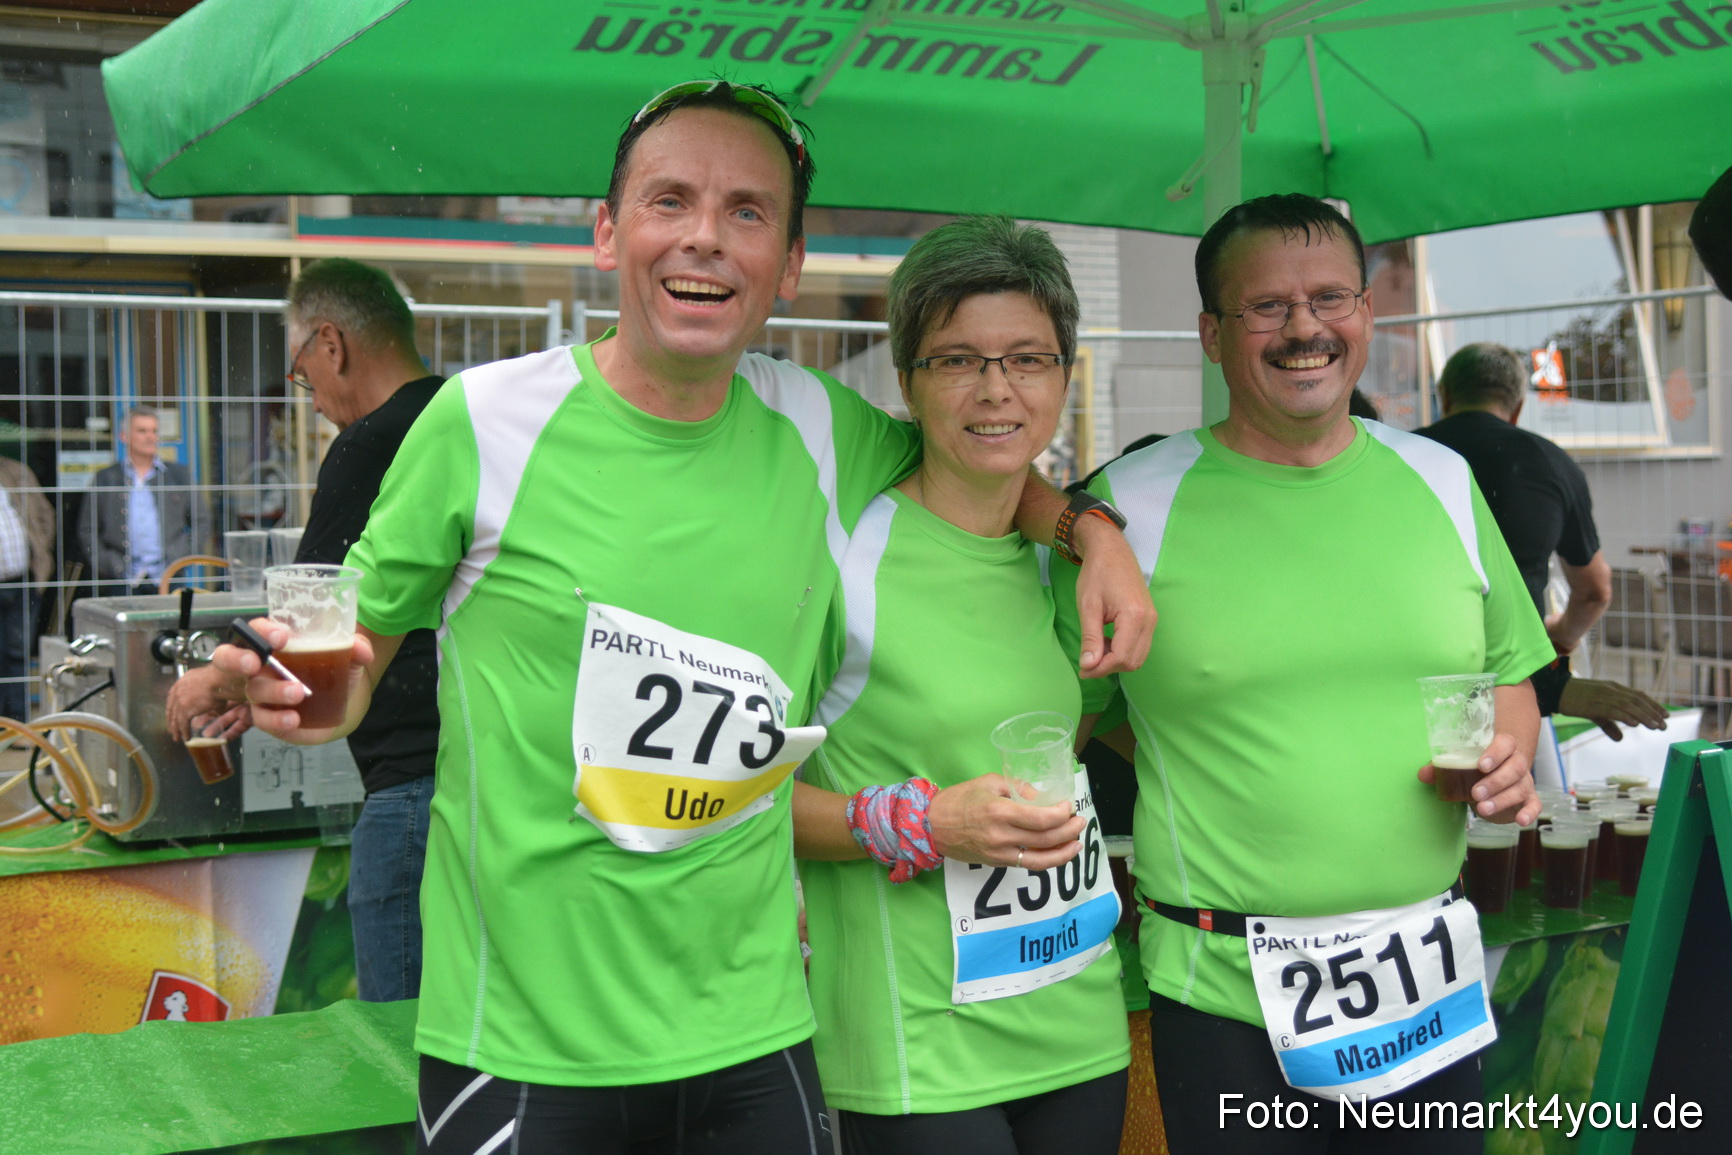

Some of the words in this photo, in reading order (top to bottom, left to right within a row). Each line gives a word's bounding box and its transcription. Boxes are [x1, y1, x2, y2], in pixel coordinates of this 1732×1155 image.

[590, 628, 675, 662] PARTL
[583, 746, 591, 762] A
[664, 787, 725, 821] Udo
[960, 918, 969, 933] C
[1019, 918, 1079, 964] Ingrid
[1281, 914, 1457, 1036] 2511
[1280, 1035, 1290, 1049] C
[1333, 1010, 1444, 1077] Manfred
